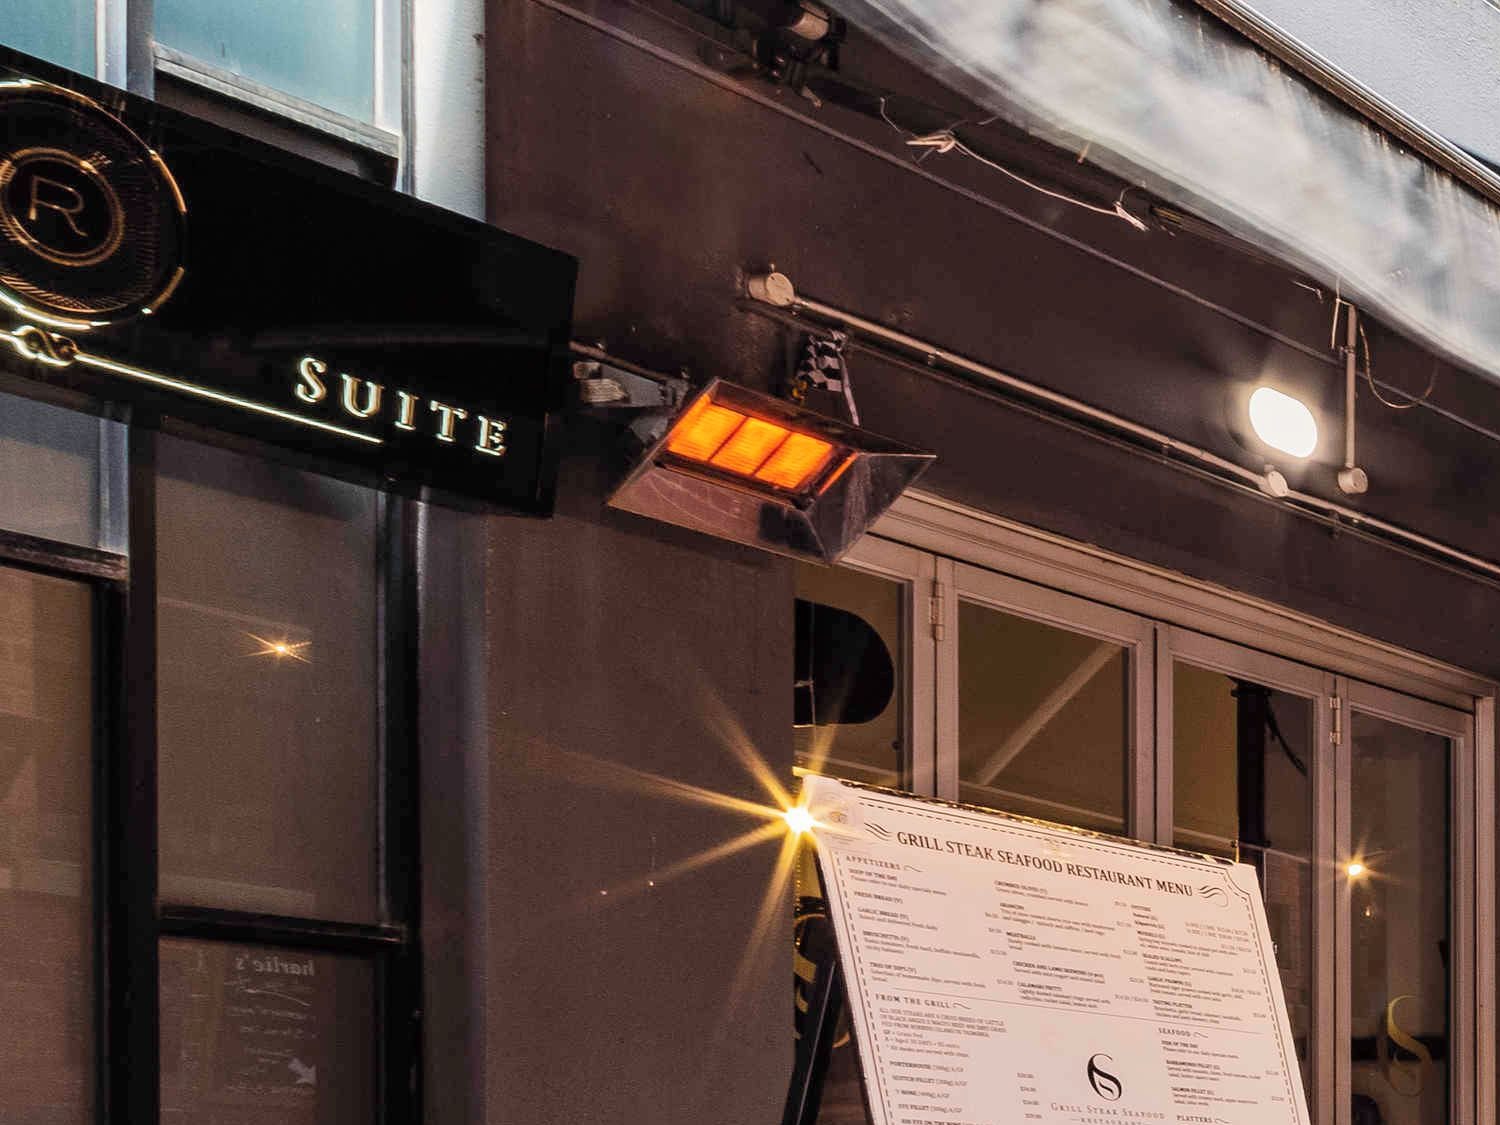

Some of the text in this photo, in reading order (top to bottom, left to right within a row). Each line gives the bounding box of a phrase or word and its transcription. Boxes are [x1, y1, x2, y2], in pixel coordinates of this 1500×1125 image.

[296, 356, 507, 456] SUITE
[895, 830, 1193, 897] GRILL STEAK SEAFOOD RESTAURANT MENU
[874, 992, 950, 1008] FROM THE GRILL
